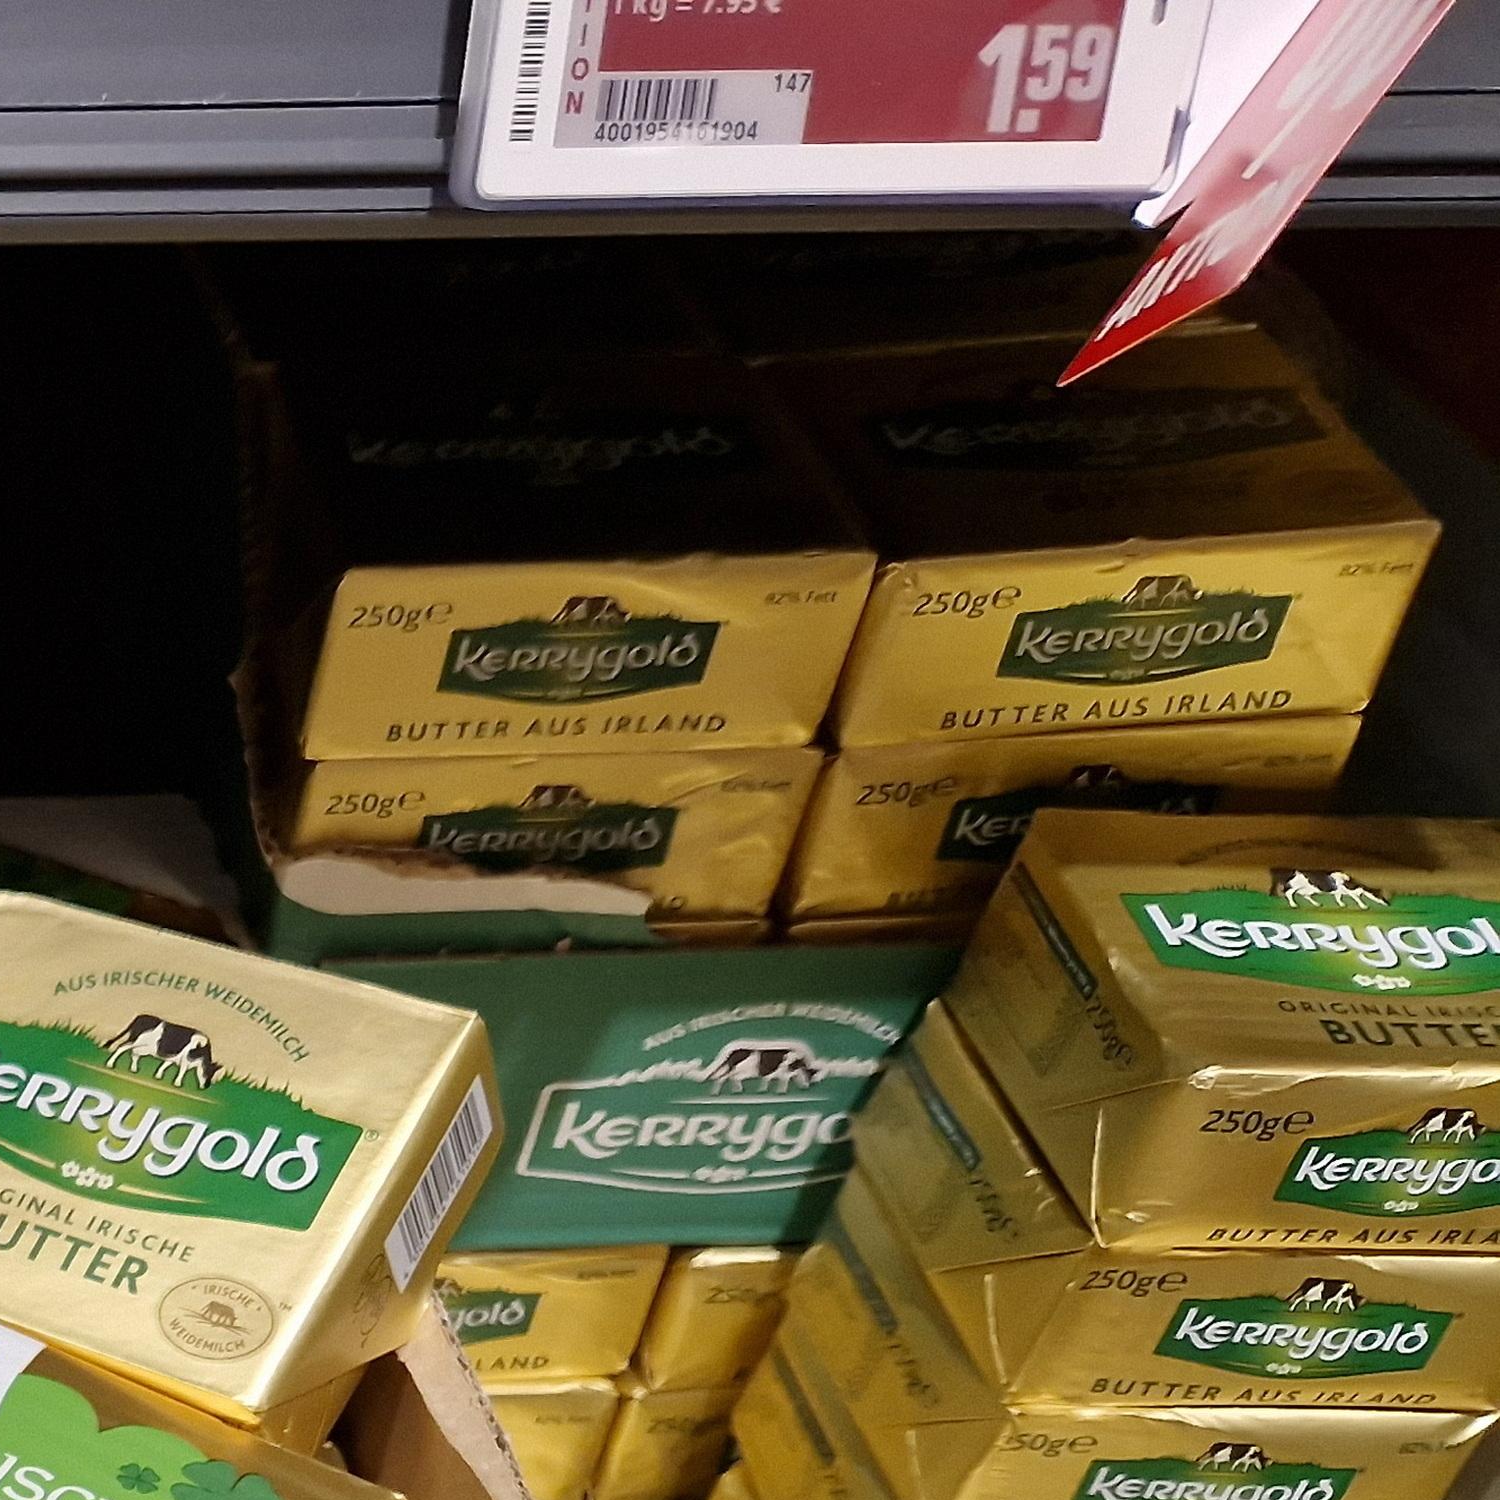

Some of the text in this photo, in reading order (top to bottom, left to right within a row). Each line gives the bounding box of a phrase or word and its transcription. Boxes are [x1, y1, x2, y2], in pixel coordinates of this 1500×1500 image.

[775, 73, 812, 92] 147
[978, 24, 1115, 133] 1.59
[1016, 609, 1270, 662] Kerrygold
[387, 715, 727, 742] BUTTER AUS IRLAND
[939, 689, 1292, 730] BUTTER AUS IRLAND
[1145, 902, 1500, 970] Kerrygol
[54, 971, 310, 1064] AUS IRISCHER WEIDEMILCH
[551, 1100, 852, 1162] Kerrygo
[86, 1216, 195, 1264] IRISCHE
[1175, 1309, 1430, 1361] Kerrygold
